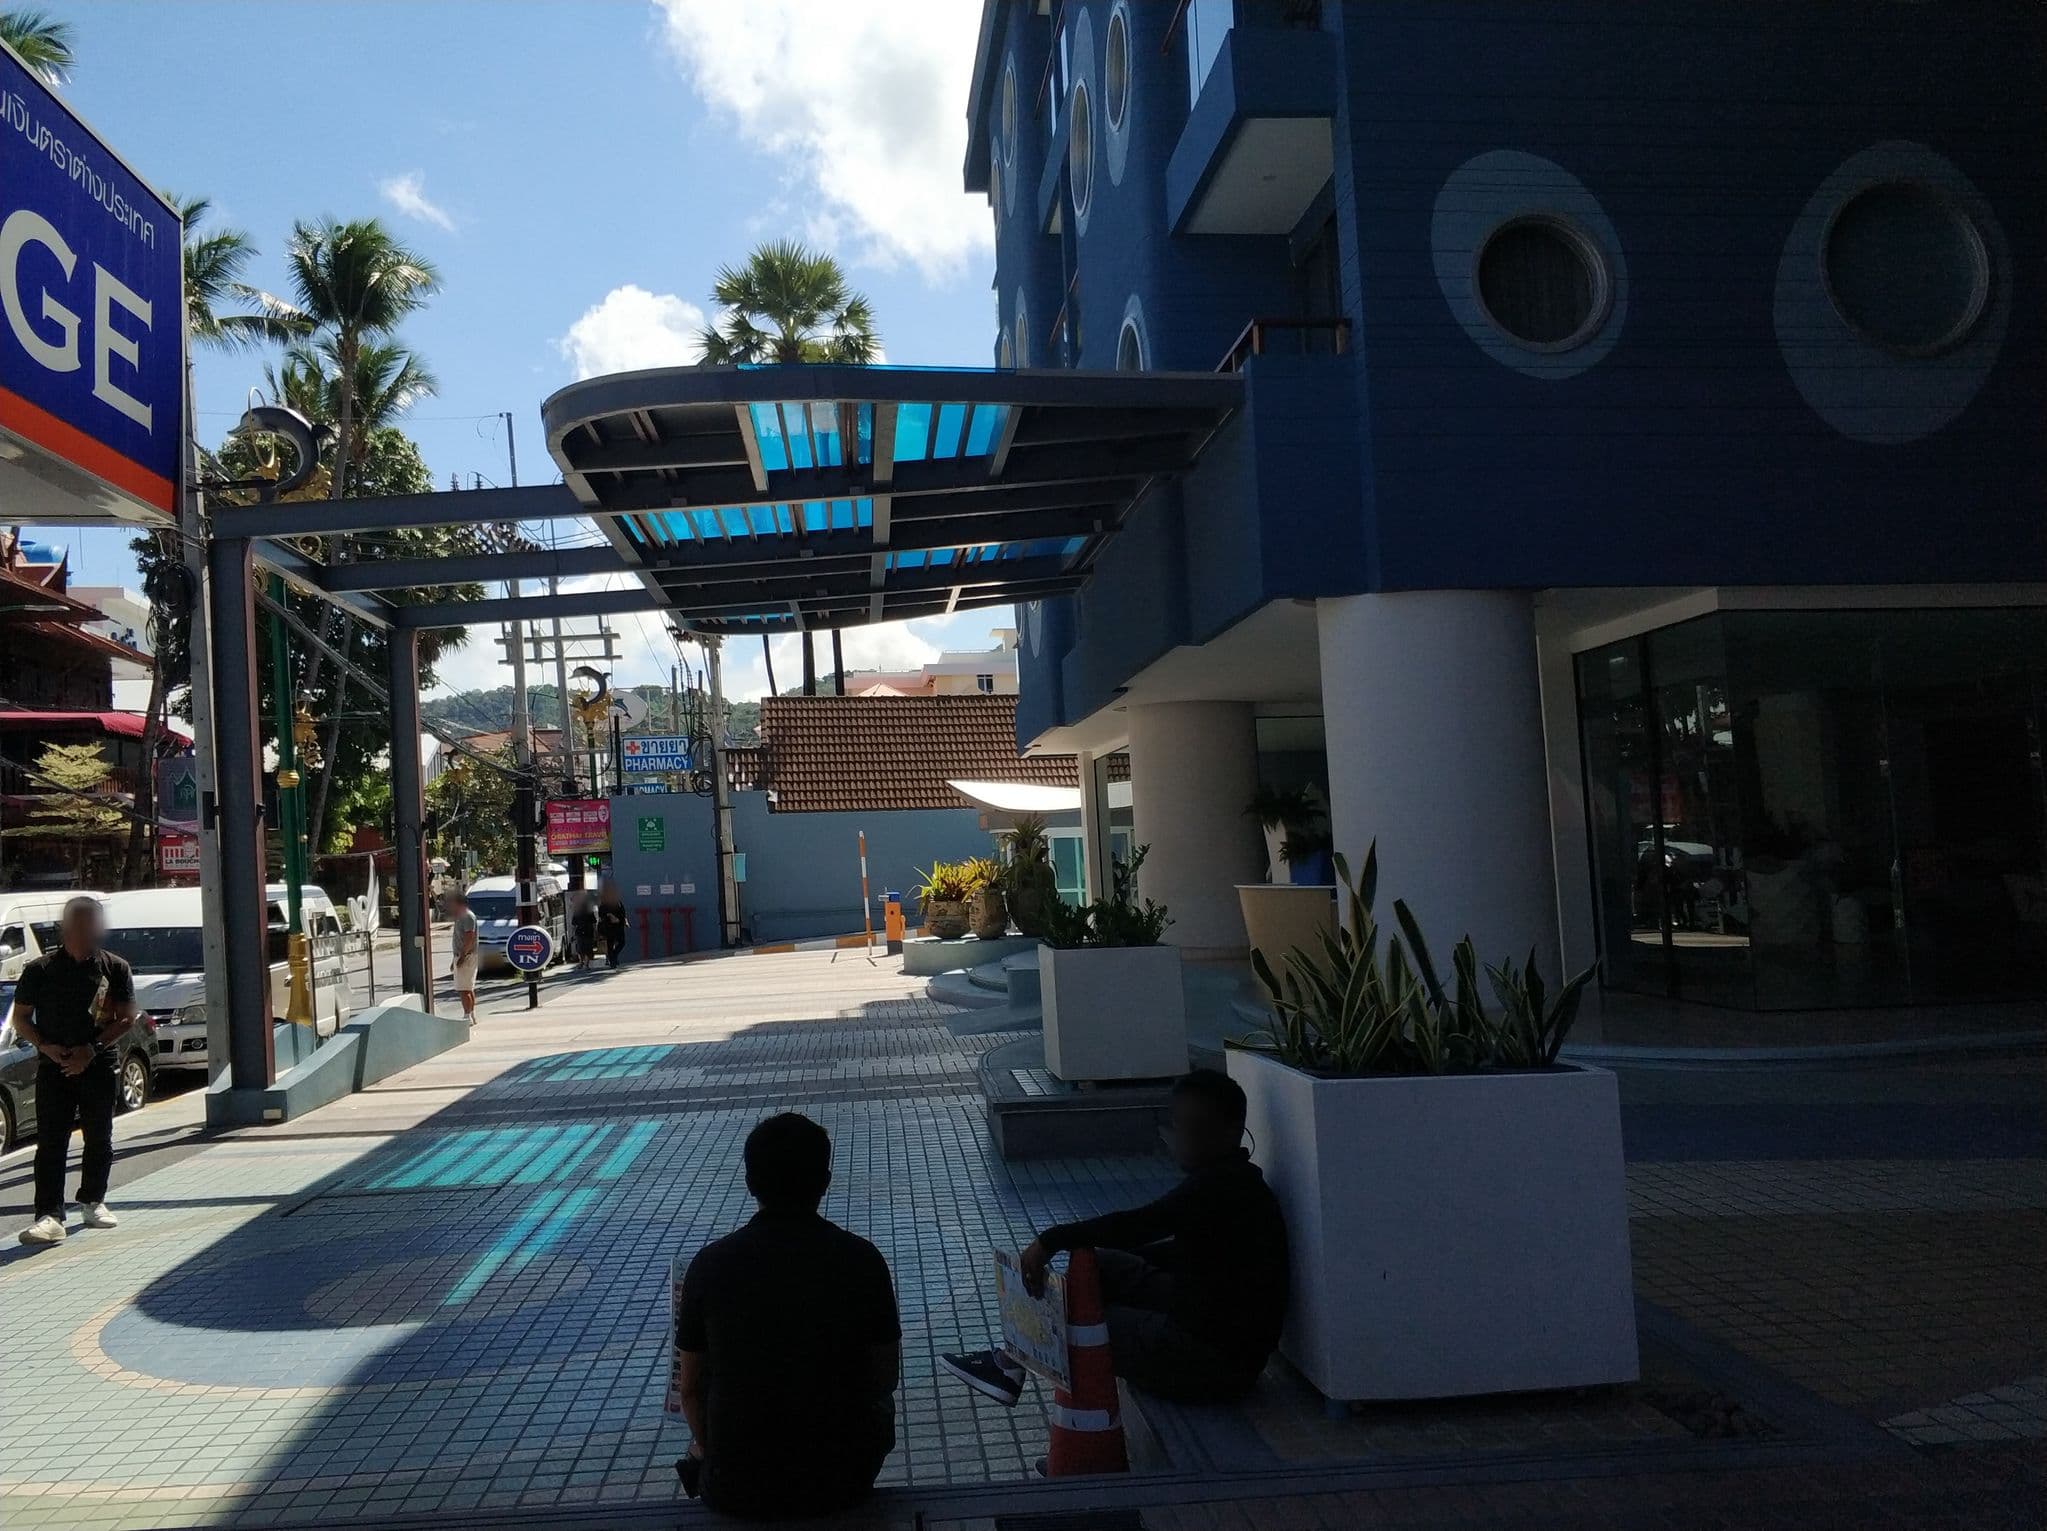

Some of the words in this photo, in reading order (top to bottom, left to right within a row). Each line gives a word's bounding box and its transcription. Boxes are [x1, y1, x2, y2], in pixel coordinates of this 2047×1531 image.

[640, 739, 687, 754] ขายยา
[625, 755, 688, 771] PHARMACY
[519, 955, 539, 964] IN
